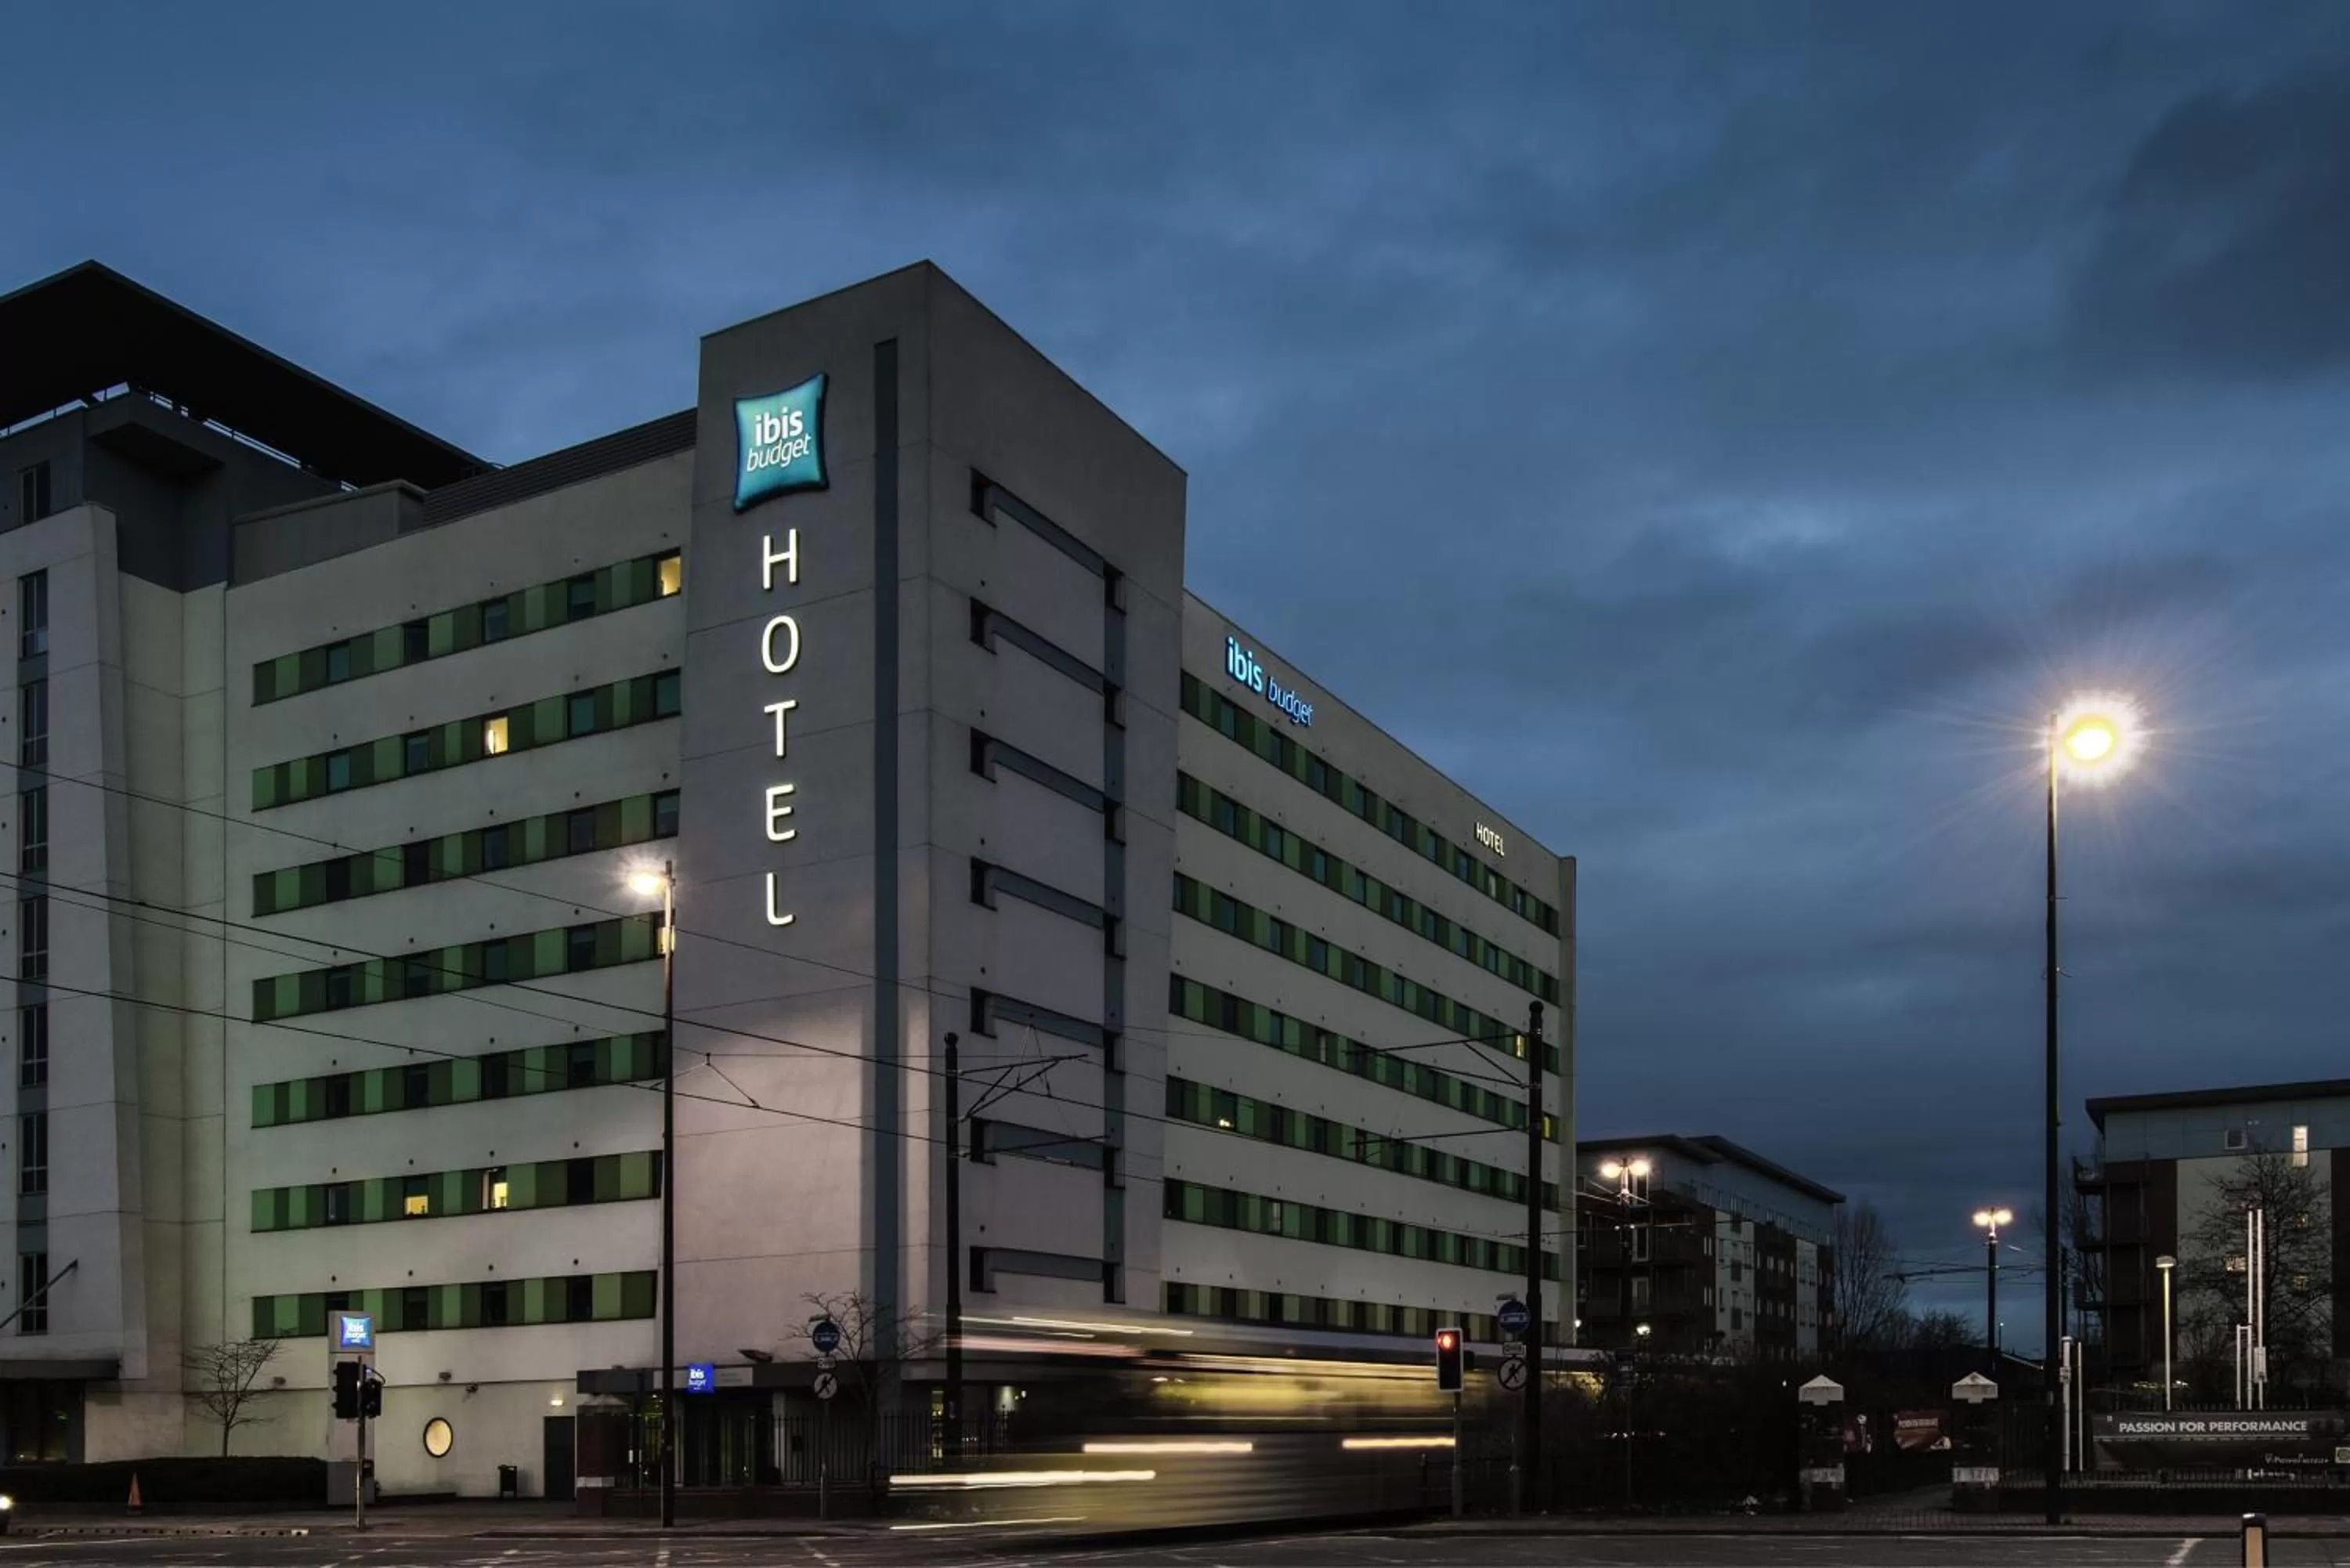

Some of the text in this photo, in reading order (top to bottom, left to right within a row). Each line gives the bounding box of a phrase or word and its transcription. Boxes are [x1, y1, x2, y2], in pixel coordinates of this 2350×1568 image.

[754, 406, 804, 448] ibis
[747, 432, 812, 473] budget
[1227, 635, 1314, 727] ibis budget
[761, 528, 801, 927] HOTEL
[1476, 822, 1505, 857] HOTEL
[2119, 1421, 2307, 1433] PASSION FOR PERFORMANCE
